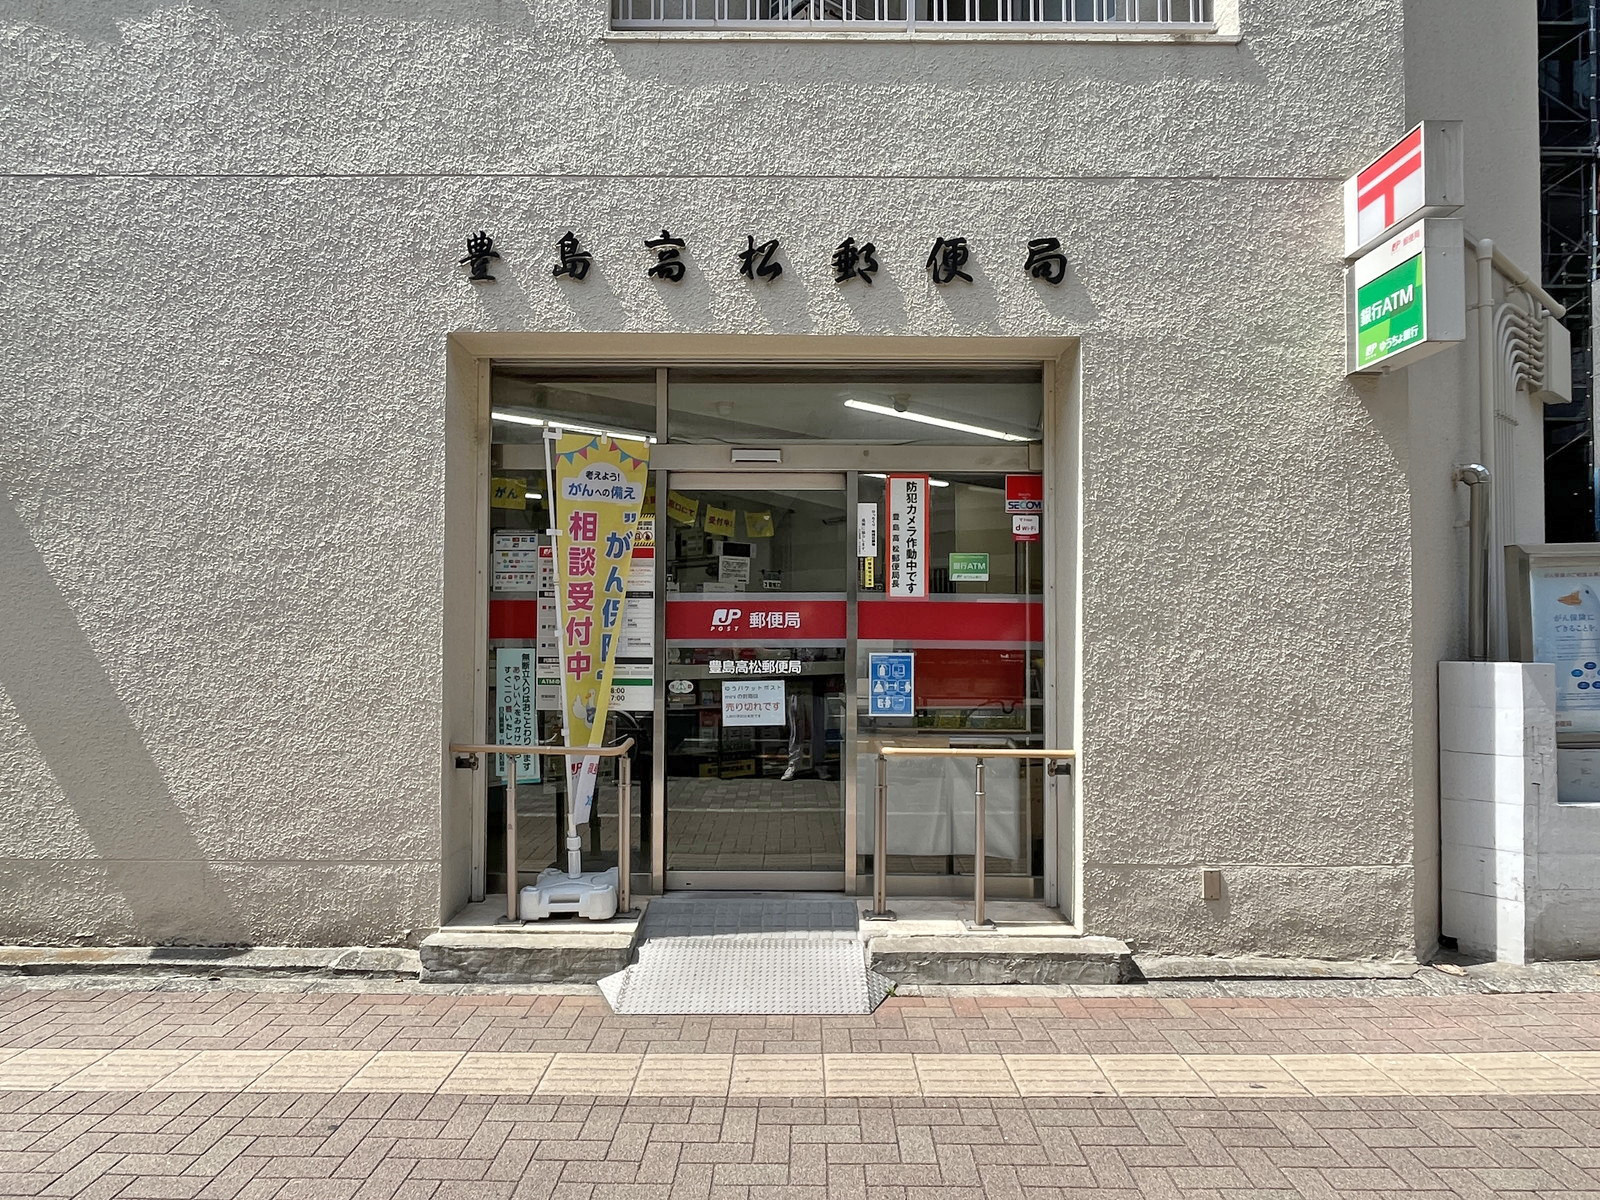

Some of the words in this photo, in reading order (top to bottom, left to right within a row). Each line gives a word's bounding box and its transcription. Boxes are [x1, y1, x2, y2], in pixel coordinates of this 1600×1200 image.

[458, 230, 1067, 286] 豊島高松郵便局
[1360, 284, 1414, 326] 銀行ATM
[1379, 324, 1419, 352] ゆうちょ銀行
[586, 470, 620, 482] 考えよう!
[568, 482, 635, 500] がんへの備え
[1008, 501, 1042, 510] SECOM
[906, 481, 917, 593] 防犯カメラ作動中です
[566, 512, 598, 680] 相談受付中
[749, 612, 800, 628] 郵便局
[709, 660, 801, 674] 豊島高松郵便局
[522, 654, 532, 771] 無断立入りはおことわります
[726, 702, 780, 712] 売り切れです
